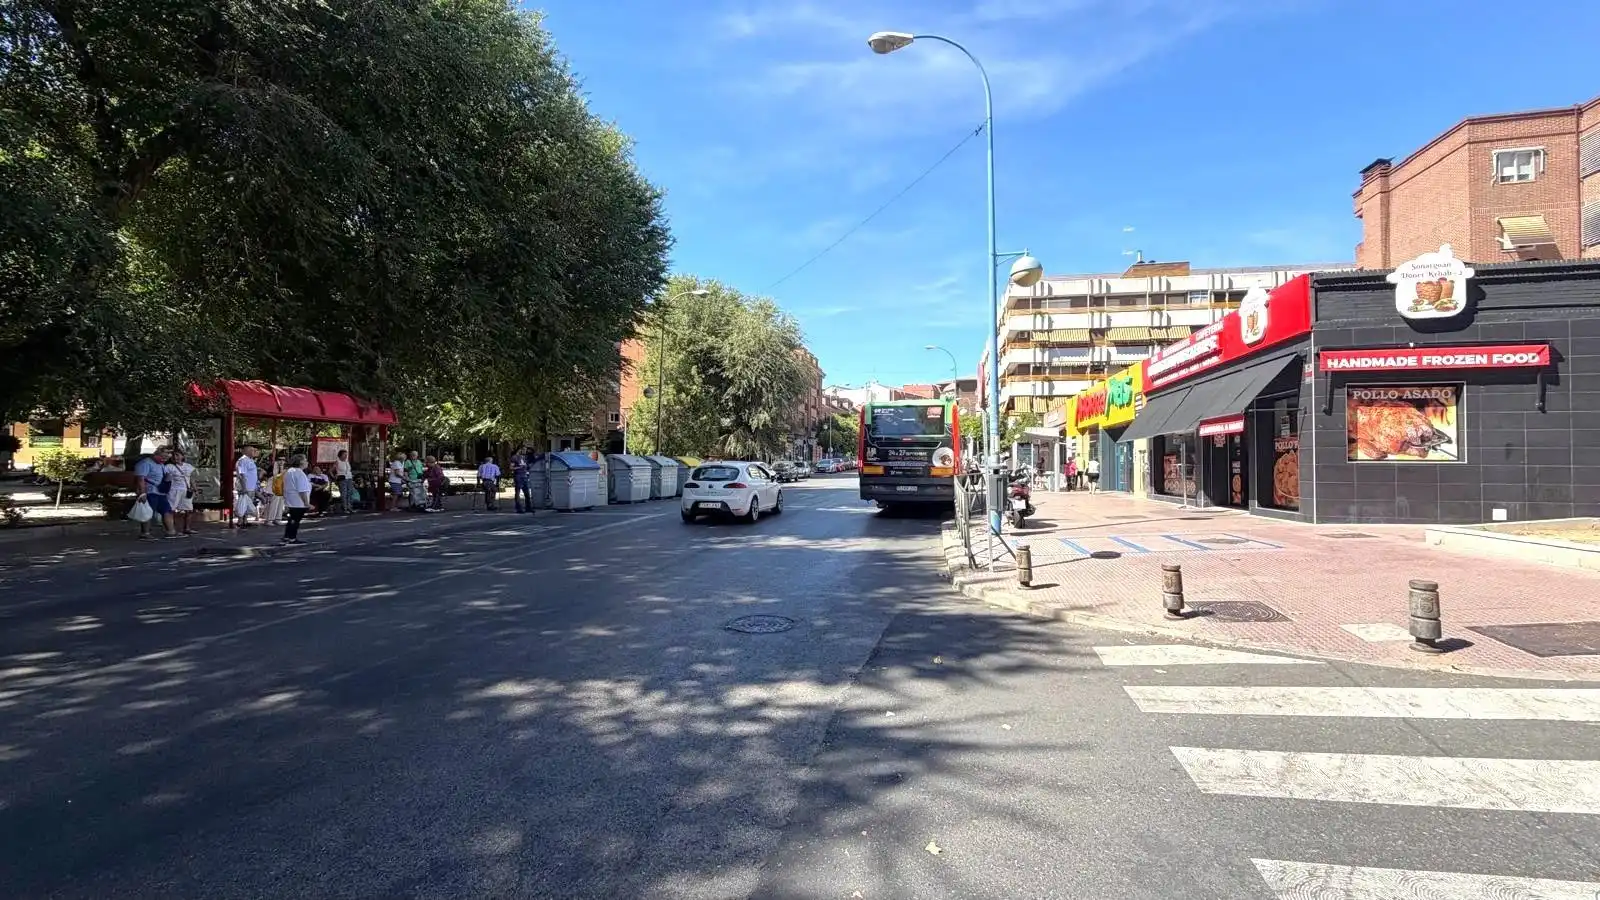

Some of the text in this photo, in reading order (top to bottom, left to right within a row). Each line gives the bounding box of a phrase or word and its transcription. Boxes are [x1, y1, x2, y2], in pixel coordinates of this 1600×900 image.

[1327, 352, 1540, 368] HANDMADE FROZEN FOOD
[1352, 389, 1451, 400] POLLO ASADO
